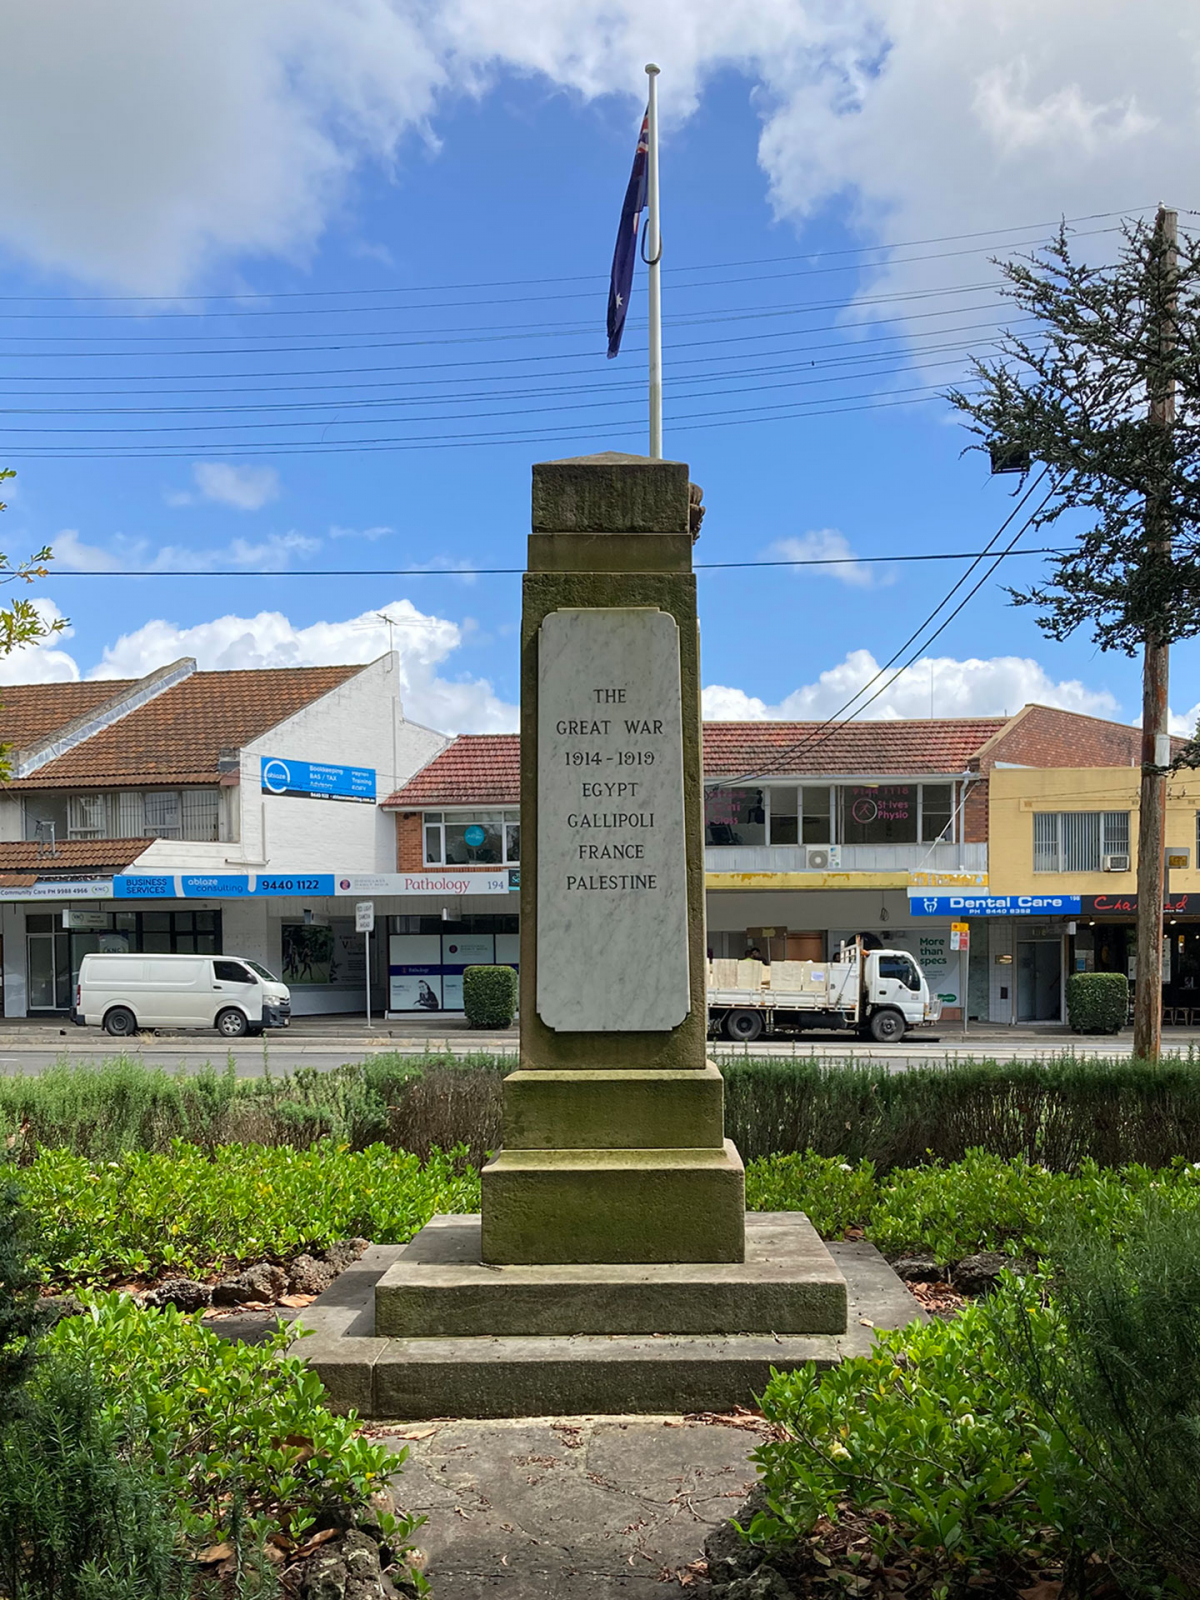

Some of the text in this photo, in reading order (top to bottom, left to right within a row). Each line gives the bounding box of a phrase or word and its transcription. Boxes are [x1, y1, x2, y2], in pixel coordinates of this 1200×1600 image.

[593, 688, 627, 704] THE
[556, 720, 663, 735] GREAT WAR
[351, 777, 372, 786] Training
[582, 783, 639, 798] EGYPT
[877, 801, 909, 809] St Ives
[877, 811, 909, 820] Physio
[567, 813, 654, 828] GALLIPOLI
[579, 844, 644, 859] FRANCE
[187, 878, 218, 886] ablaze
[262, 880, 319, 890] 9440 1122
[404, 878, 471, 894] Pathology
[487, 881, 504, 890] 194
[567, 874, 657, 890] PALESTINE
[126, 886, 166, 894] SERVICES
[196, 884, 243, 893] consulting
[950, 896, 1063, 908] Dental Care
[920, 937, 945, 946] More
[920, 947, 943, 955] than
[920, 957, 947, 966] specs
